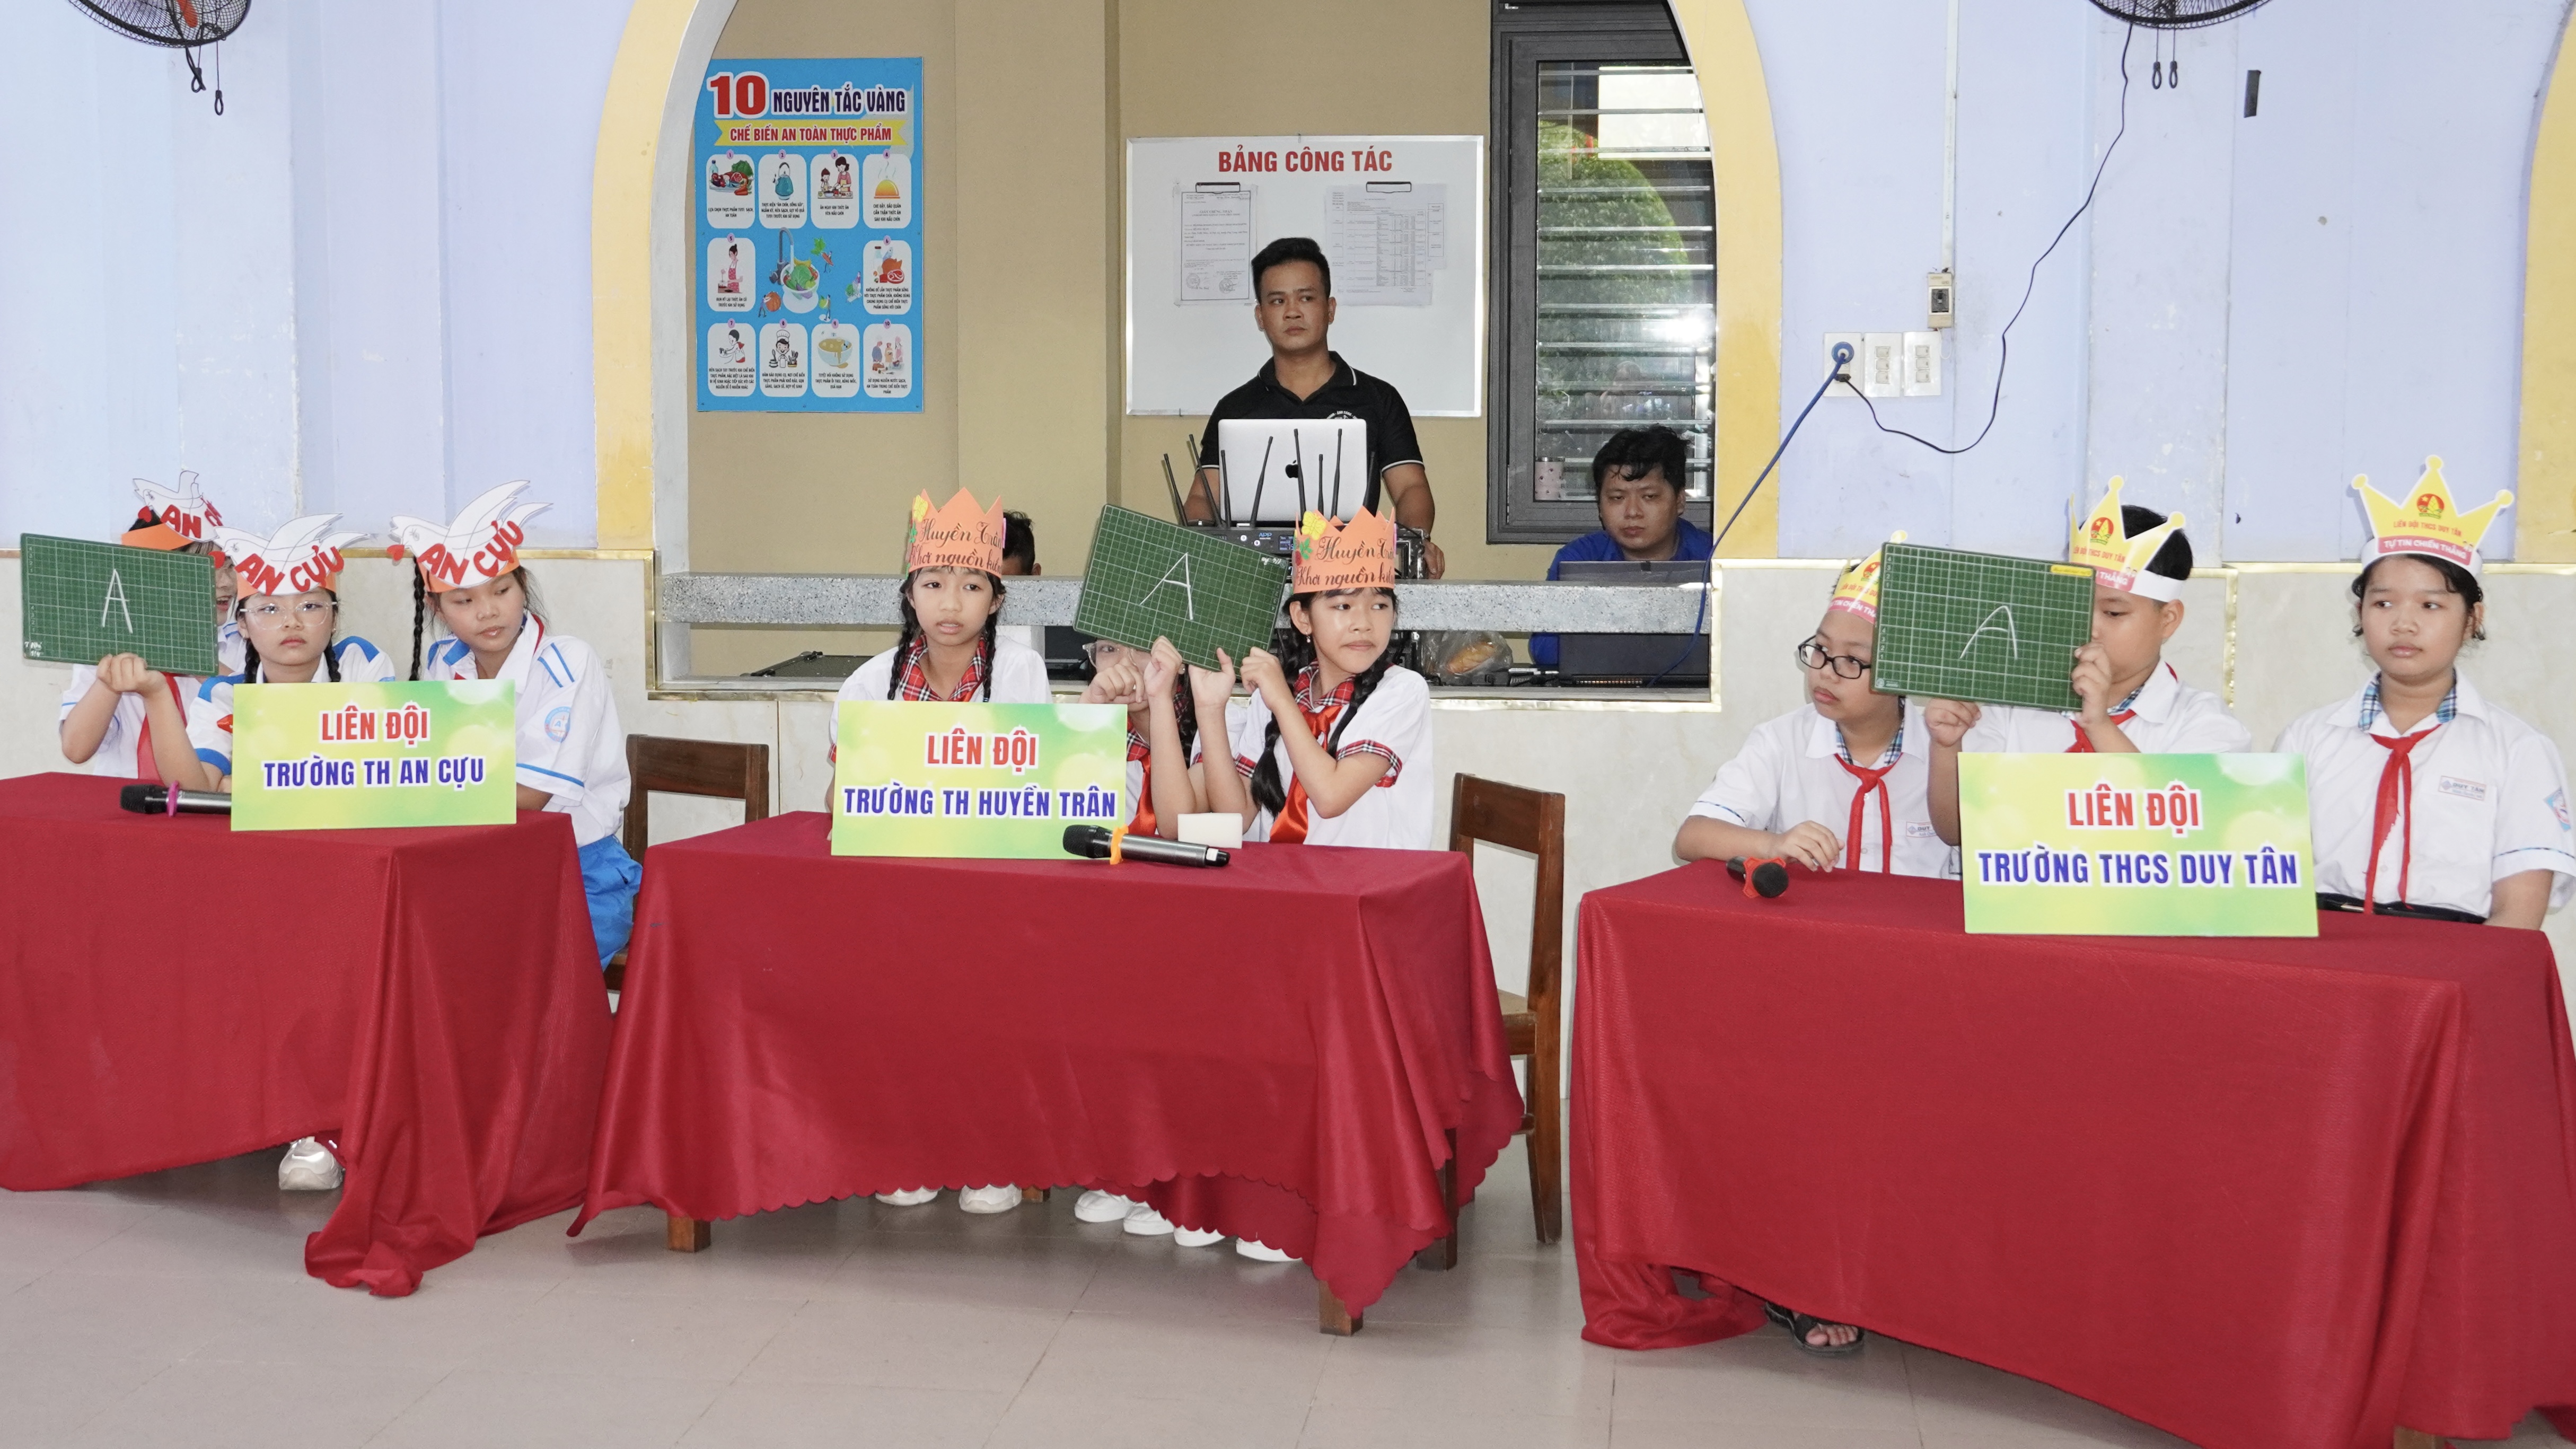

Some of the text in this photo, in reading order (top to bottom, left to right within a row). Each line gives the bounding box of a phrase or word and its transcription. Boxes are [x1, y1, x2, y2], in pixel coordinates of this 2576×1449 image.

[710, 75, 905, 115] 10 NGUYÊN TẮC VÀNG
[730, 123, 891, 144] CHẾ BIẾN AN TOÀN THỰC PHẨM
[1219, 145, 1392, 172] BẢNG CÔNG TÁC
[161, 504, 201, 539] AN
[920, 518, 972, 548] Huyền
[417, 520, 524, 585] AN CỰU
[935, 548, 984, 567] nguồn
[1315, 536, 1376, 565] Huyền
[2384, 539, 2397, 549] TỰ
[2413, 539, 2439, 549] CHIẾN
[2440, 543, 2467, 559] THẮNG
[235, 545, 344, 596] AN CỰU
[1139, 551, 1193, 620] A
[1325, 566, 1376, 589] nguồn
[2100, 571, 2128, 585] THẮNG
[102, 568, 133, 634] A
[1960, 605, 2017, 660] A
[322, 705, 427, 744] LIÊN ĐỘI
[928, 728, 1036, 772] LIÊN ĐỘI
[265, 755, 483, 788] TRƯỜNG TH AN CỰU
[845, 781, 1115, 817] TRƯỜNG TH HUYỀN TRÂN
[2069, 784, 2199, 834] LIÊN ĐỘI
[1978, 845, 2298, 884] TRƯỜNG THCS DUY TÂN
